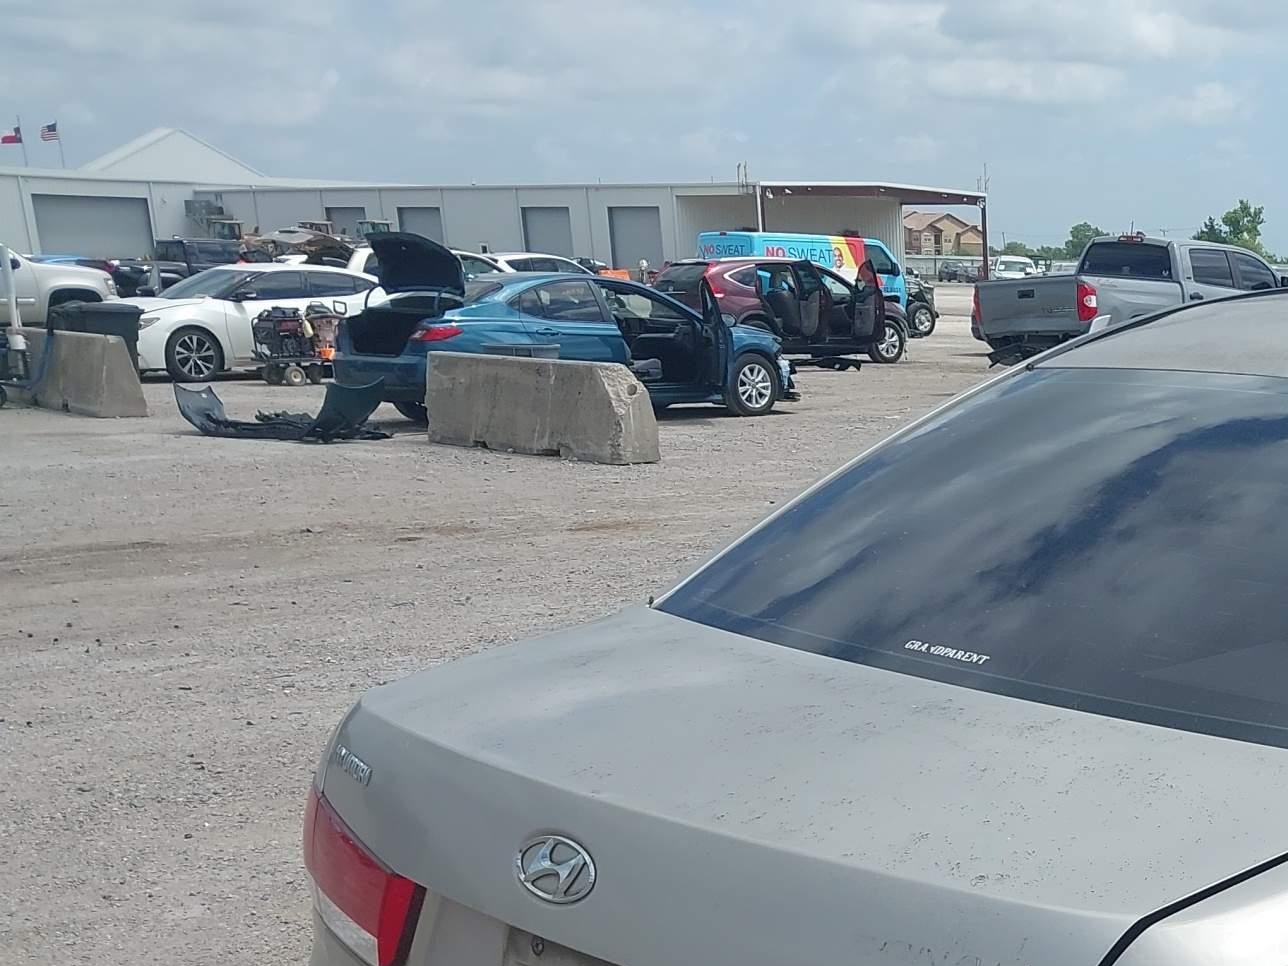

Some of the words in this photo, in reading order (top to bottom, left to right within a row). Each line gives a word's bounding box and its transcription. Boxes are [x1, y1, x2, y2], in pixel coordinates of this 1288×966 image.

[704, 244, 714, 255] NO
[715, 244, 745, 256] SWEAT
[766, 246, 786, 257] NO
[788, 247, 833, 264] SWEAT
